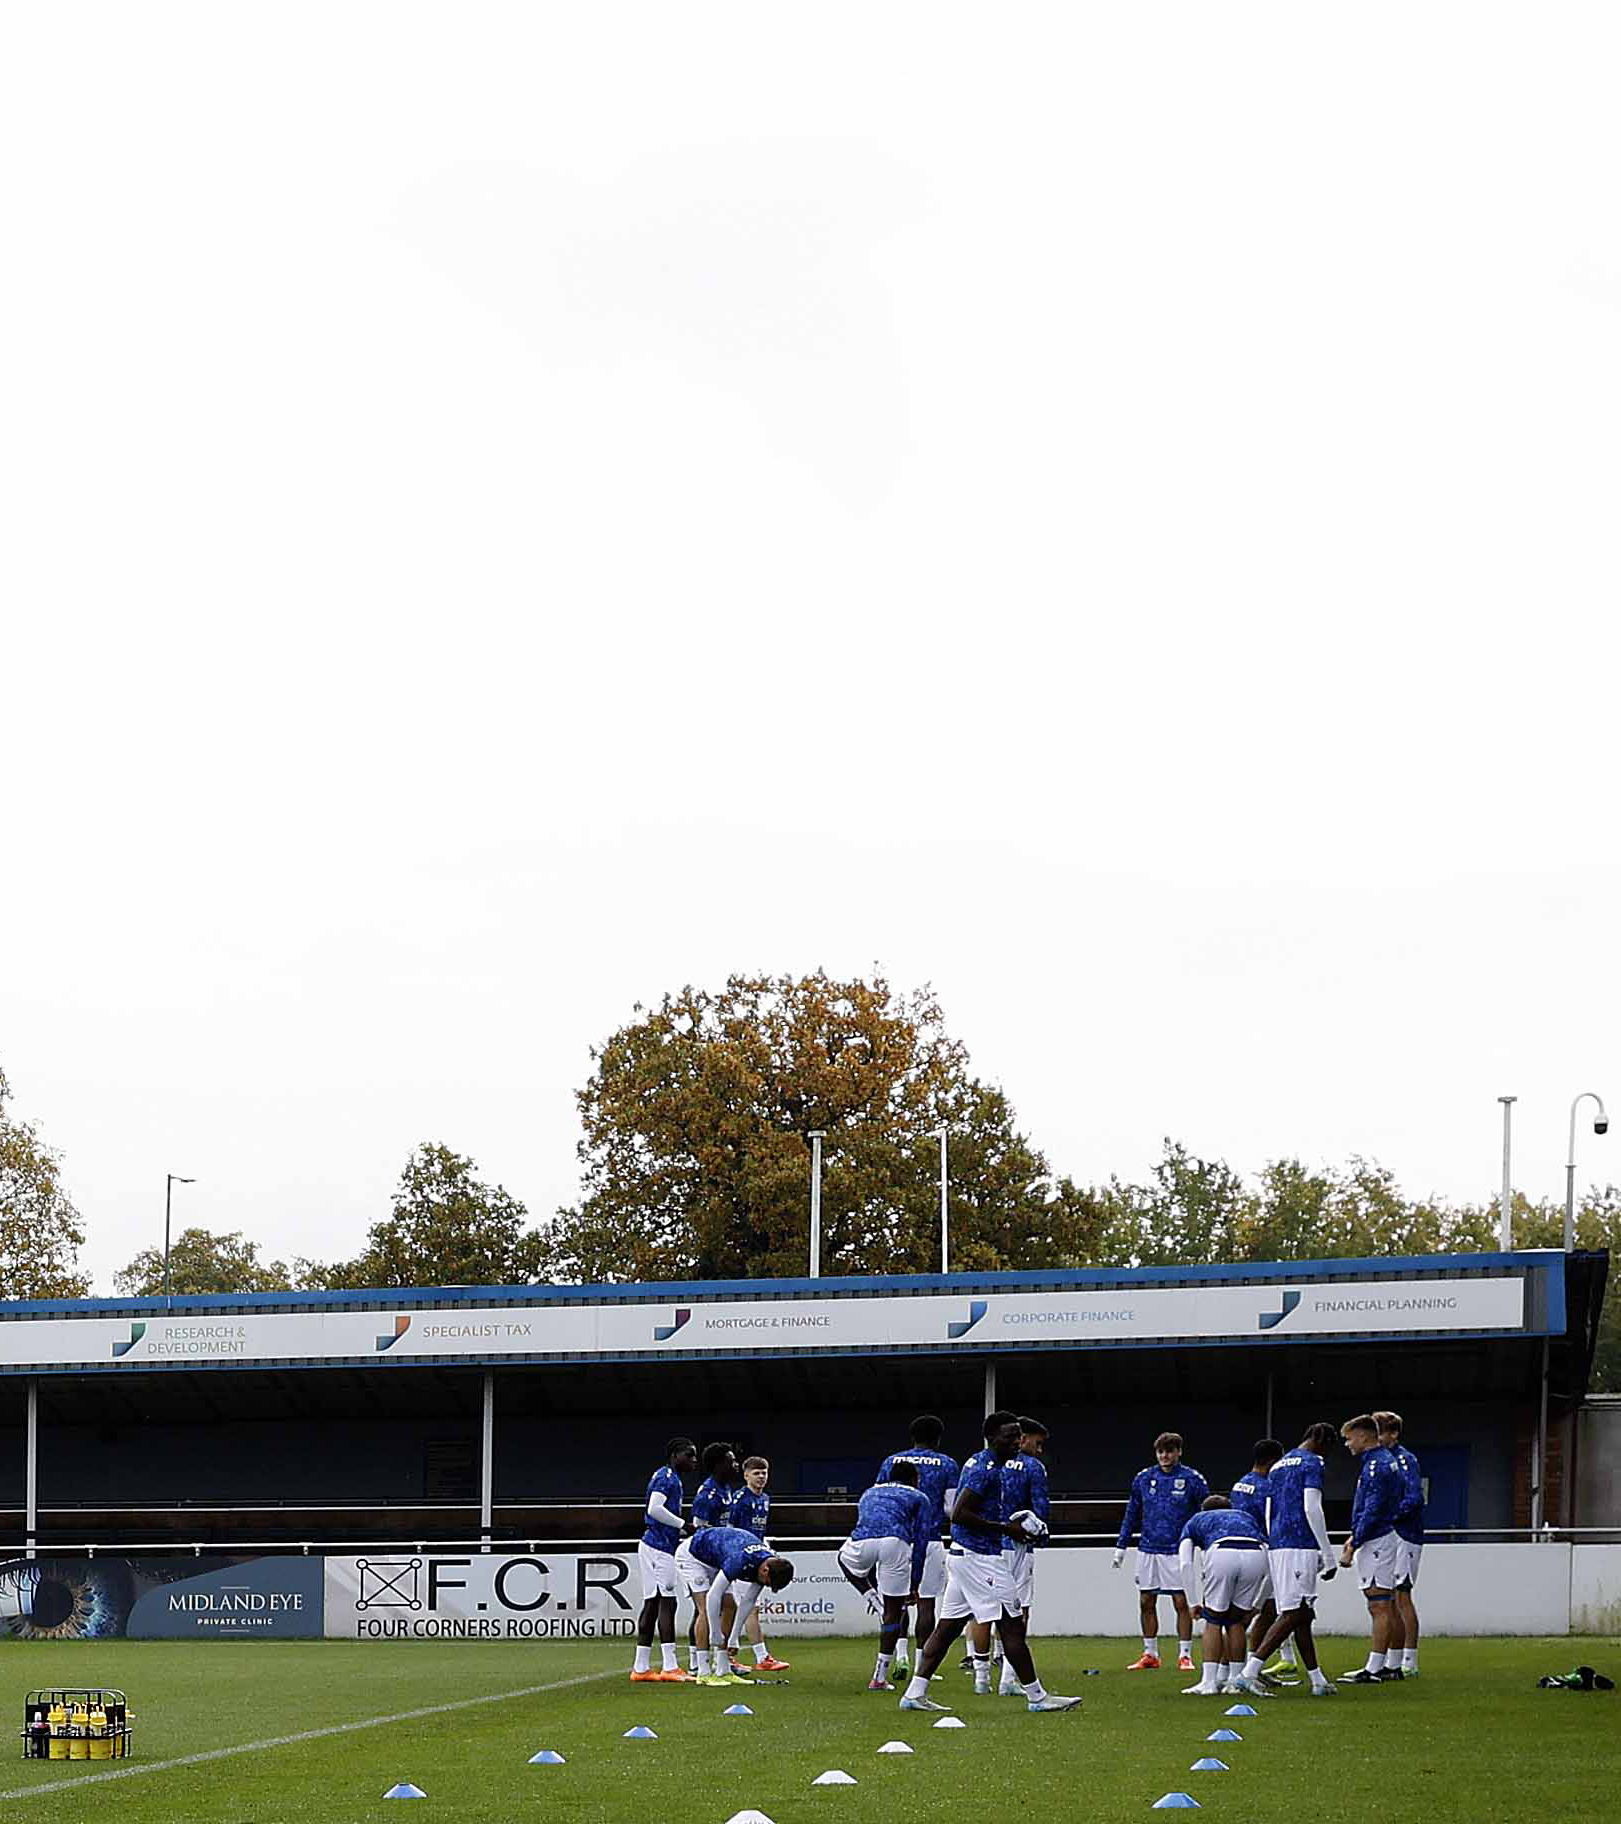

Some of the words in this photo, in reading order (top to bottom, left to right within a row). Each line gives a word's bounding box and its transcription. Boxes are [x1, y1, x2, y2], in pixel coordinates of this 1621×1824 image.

[1315, 1298, 1386, 1313] FINANCIAL
[1387, 1296, 1457, 1310] PLANNING
[705, 1317, 770, 1329] MORTGAGE
[771, 1317, 779, 1327] &
[781, 1315, 830, 1327] FINANCE
[1003, 1310, 1079, 1324] CORPORATE
[1081, 1309, 1135, 1322] FINANCE
[165, 1327, 234, 1339] RESEARCH
[236, 1326, 246, 1337] &
[423, 1323, 501, 1337] SPECIALIST
[504, 1323, 532, 1336] TAX
[148, 1341, 246, 1354] DEVELOPMENT
[809, 1575, 848, 1584] Commu
[168, 1594, 265, 1611] MIDLAND
[270, 1594, 303, 1611] EYE
[357, 1618, 408, 1637] FOUR
[413, 1618, 501, 1637] CORNERS
[508, 1617, 596, 1637] ROOFING
[601, 1618, 636, 1637] LTD
